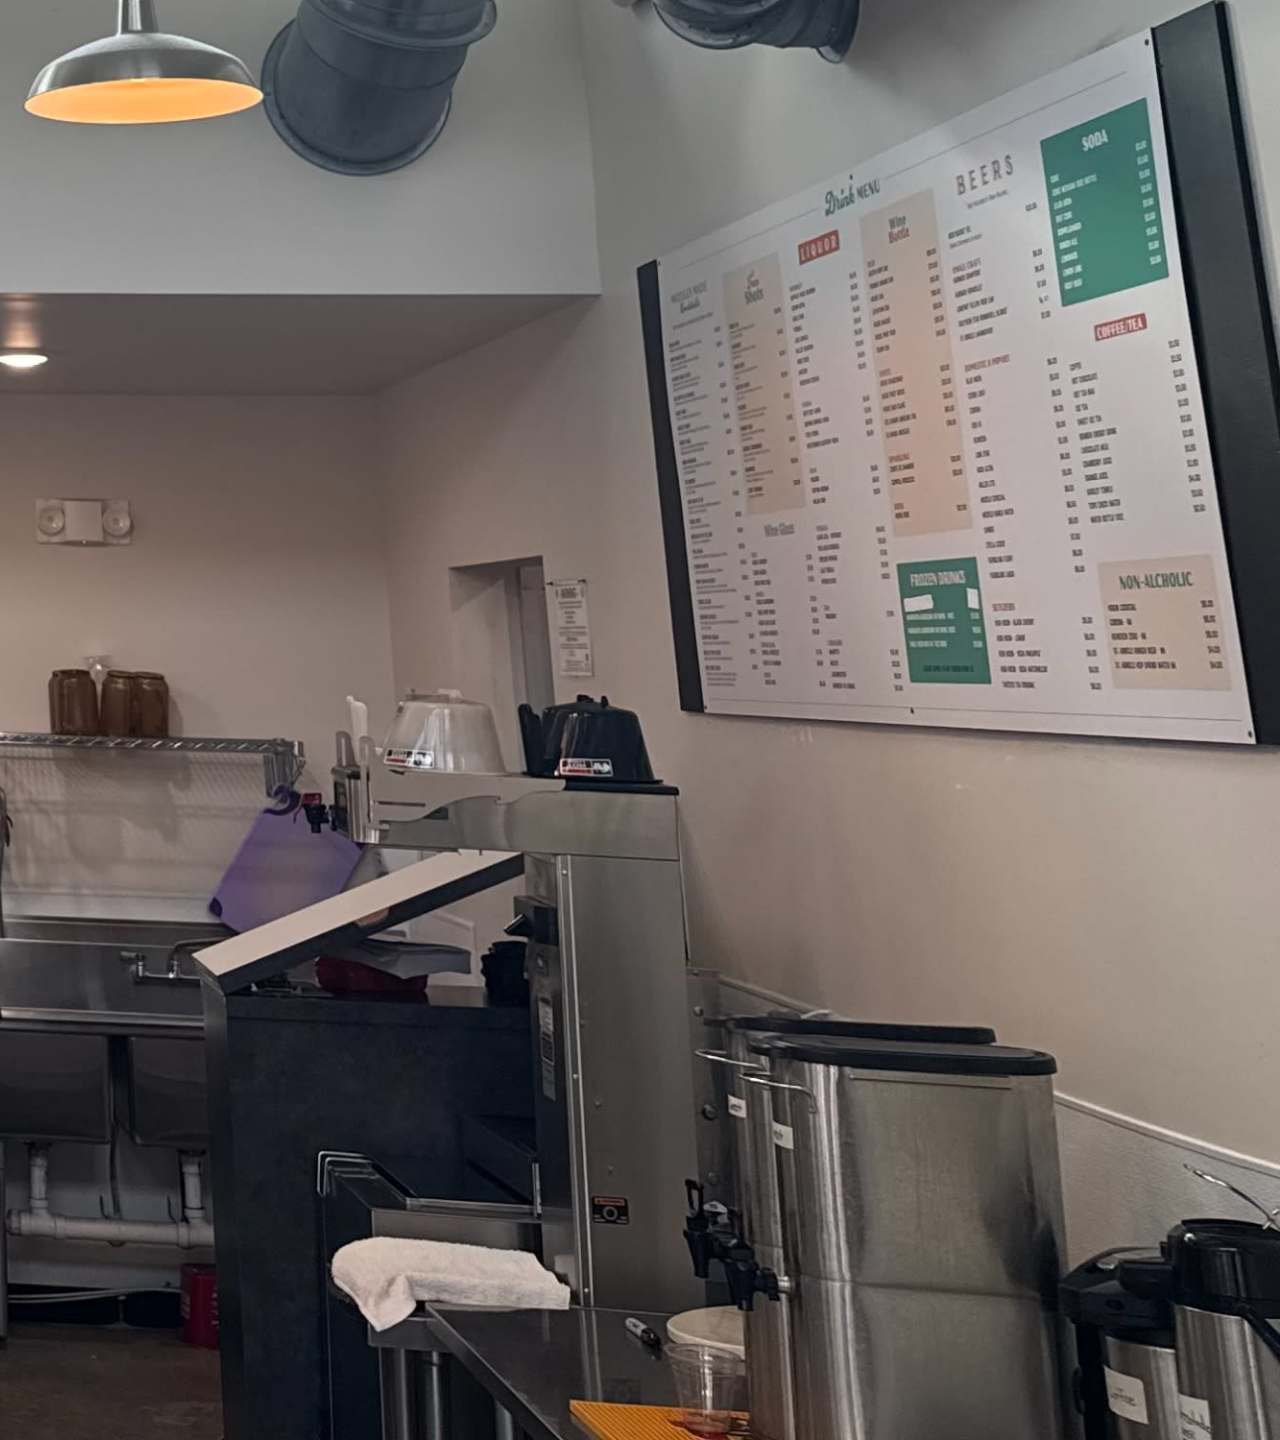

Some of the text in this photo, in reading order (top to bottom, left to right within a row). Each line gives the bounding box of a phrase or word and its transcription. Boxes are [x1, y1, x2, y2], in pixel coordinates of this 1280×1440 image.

[1082, 129, 1109, 151] SODA
[955, 155, 1015, 195] BEERS
[824, 179, 881, 216] Drink MENU
[800, 234, 839, 262] LIQUOR
[1096, 317, 1144, 339] COFFEE/TEA
